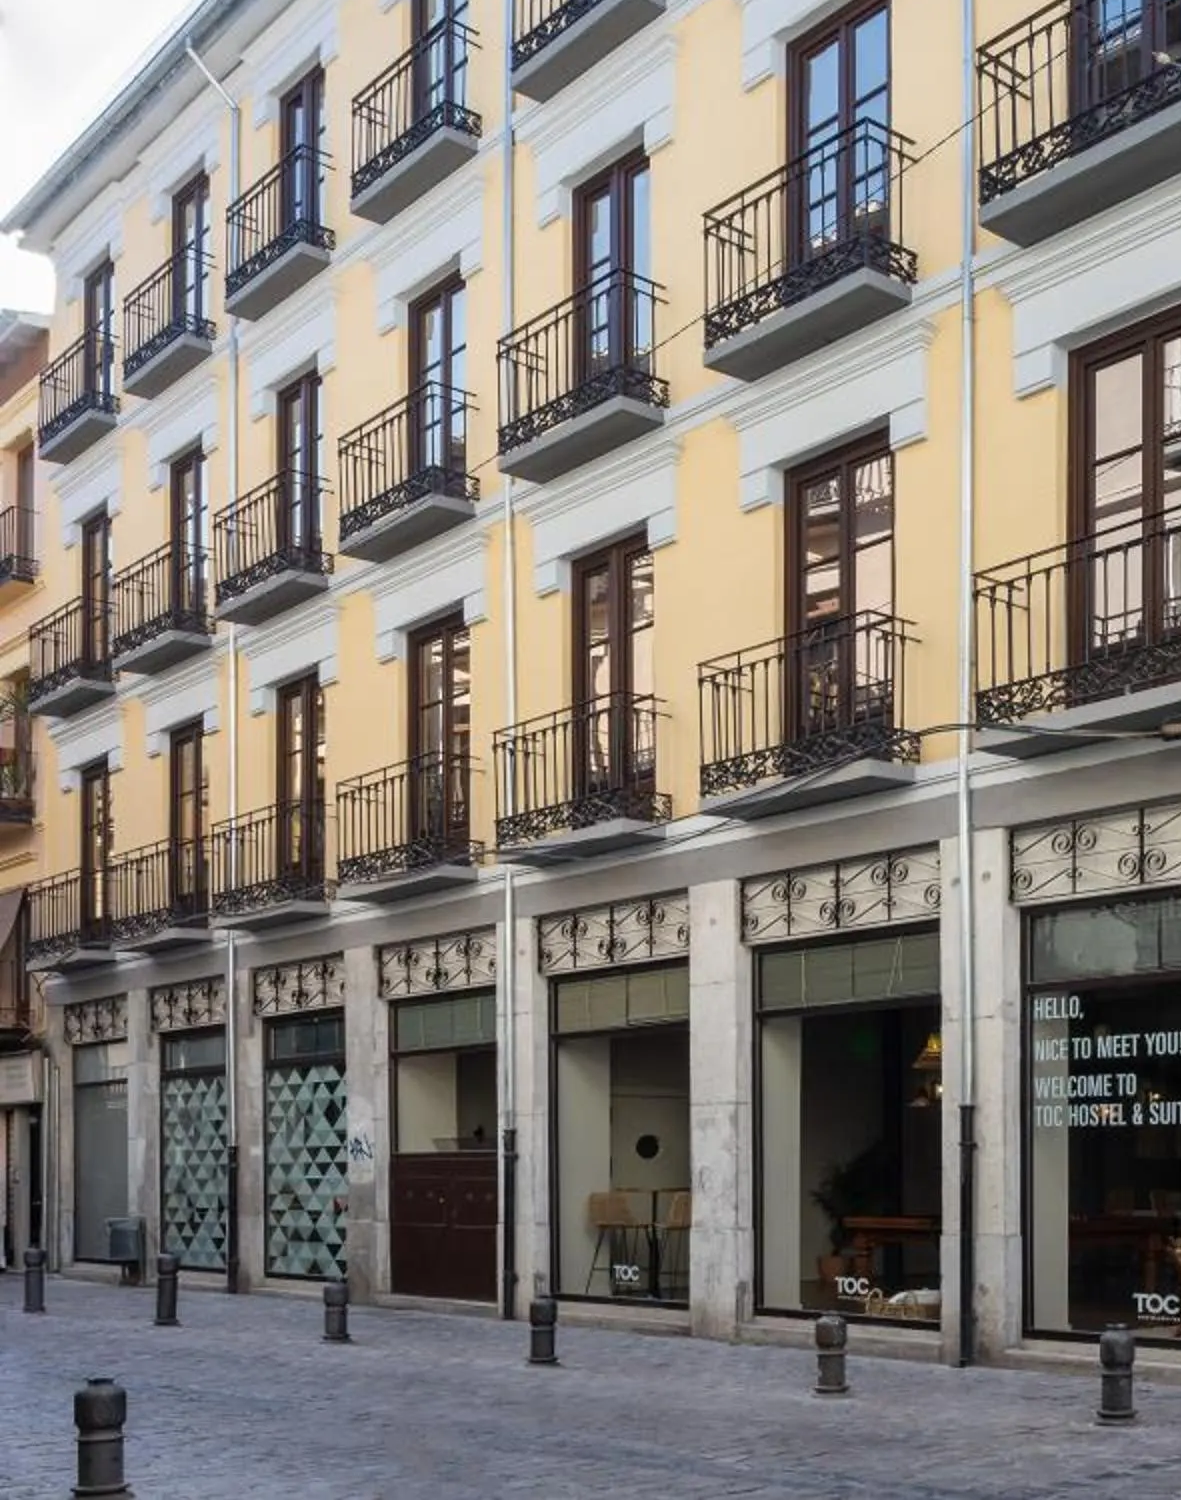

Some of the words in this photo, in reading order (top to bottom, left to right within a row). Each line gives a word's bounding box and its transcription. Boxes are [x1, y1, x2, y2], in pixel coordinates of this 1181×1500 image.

[1034, 996, 1085, 1020] HELLO,
[1034, 1038, 1068, 1061] NICE
[1072, 1037, 1091, 1060] TO
[1097, 1033, 1140, 1059] MEET
[1034, 1075, 1113, 1099] WELCOME
[1116, 1073, 1137, 1097] TO
[1036, 1105, 1063, 1127] TOC
[1067, 1103, 1127, 1127] HOSTEL
[1132, 1102, 1144, 1126] &
[612, 1265, 640, 1281] TOC
[834, 1276, 869, 1295] TOC
[1131, 1293, 1180, 1315] TOC
